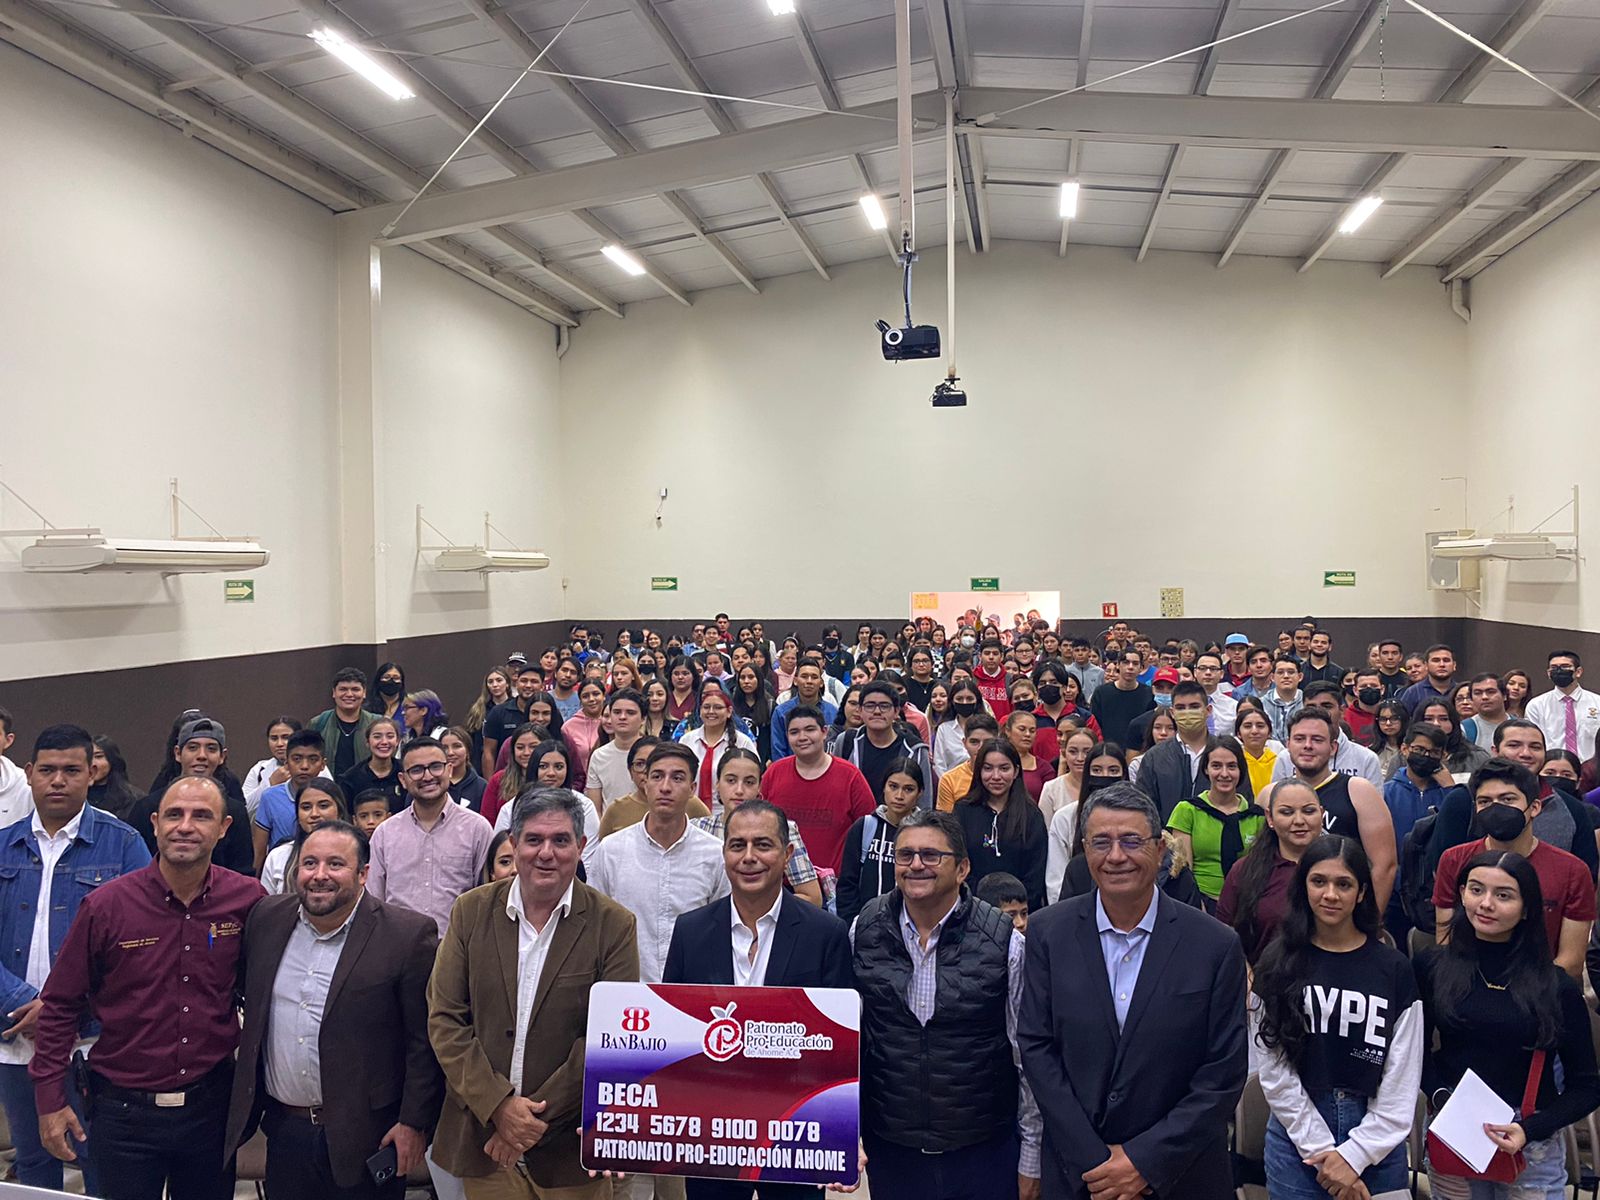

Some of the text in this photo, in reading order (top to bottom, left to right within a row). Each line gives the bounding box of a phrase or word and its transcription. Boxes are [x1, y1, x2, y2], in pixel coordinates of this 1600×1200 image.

[746, 1022, 805, 1035] Patronato
[746, 1034, 832, 1049] Pro-Educación
[745, 1048, 756, 1056] de
[757, 1049, 784, 1057] Ahome
[598, 1082, 658, 1108] BECA
[596, 1111, 821, 1143] 1234 5678 9100 0078
[594, 1138, 846, 1172] PATRONATO PRO-EDUCACIÓN AHOME
